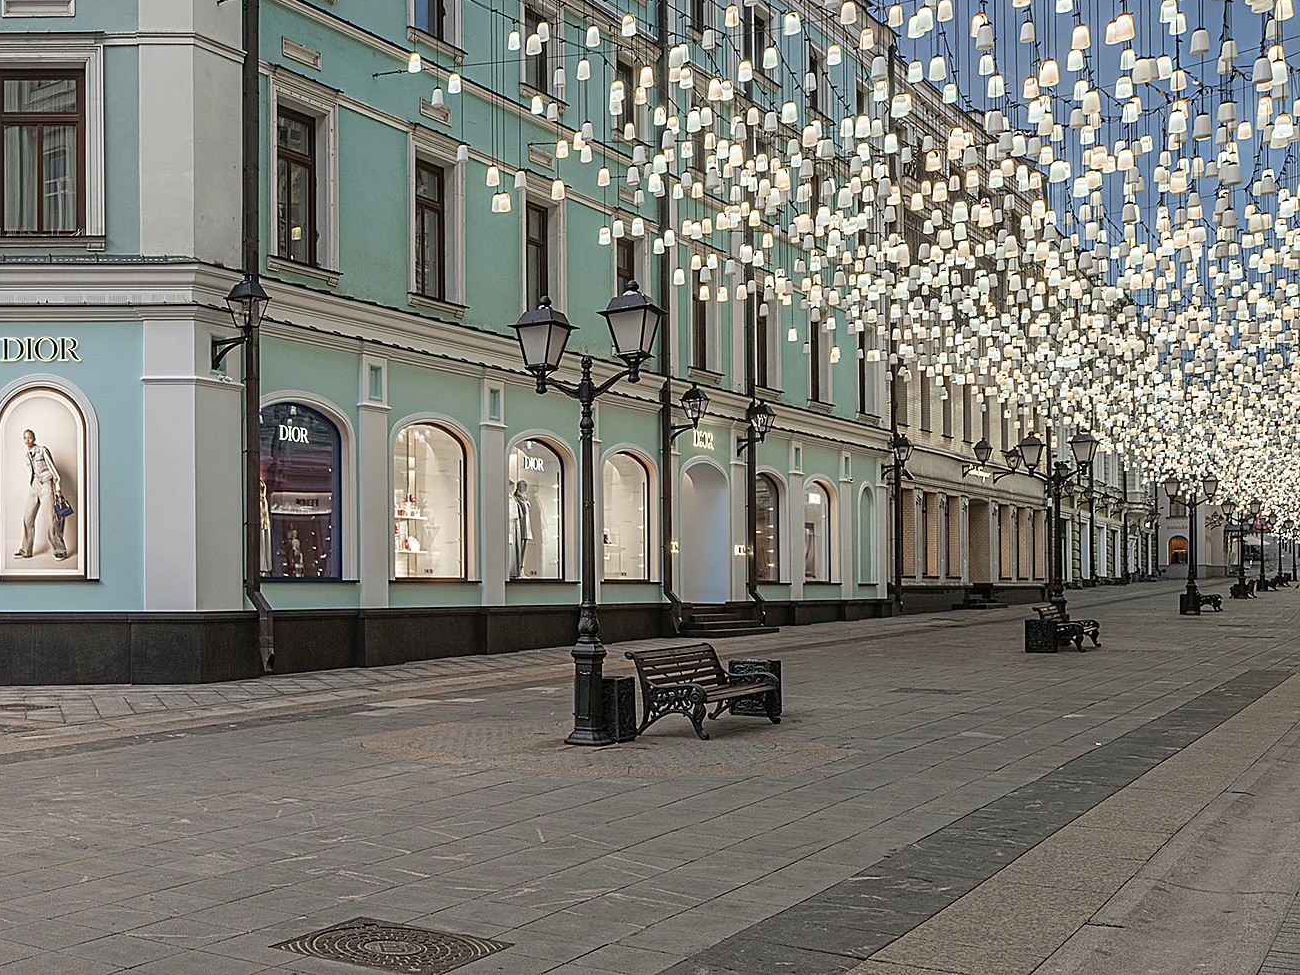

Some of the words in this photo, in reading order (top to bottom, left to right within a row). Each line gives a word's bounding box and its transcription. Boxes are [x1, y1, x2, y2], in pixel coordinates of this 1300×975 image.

[0, 336, 82, 362] DIOR
[279, 425, 309, 443] DIOR
[524, 456, 545, 472] DIOR
